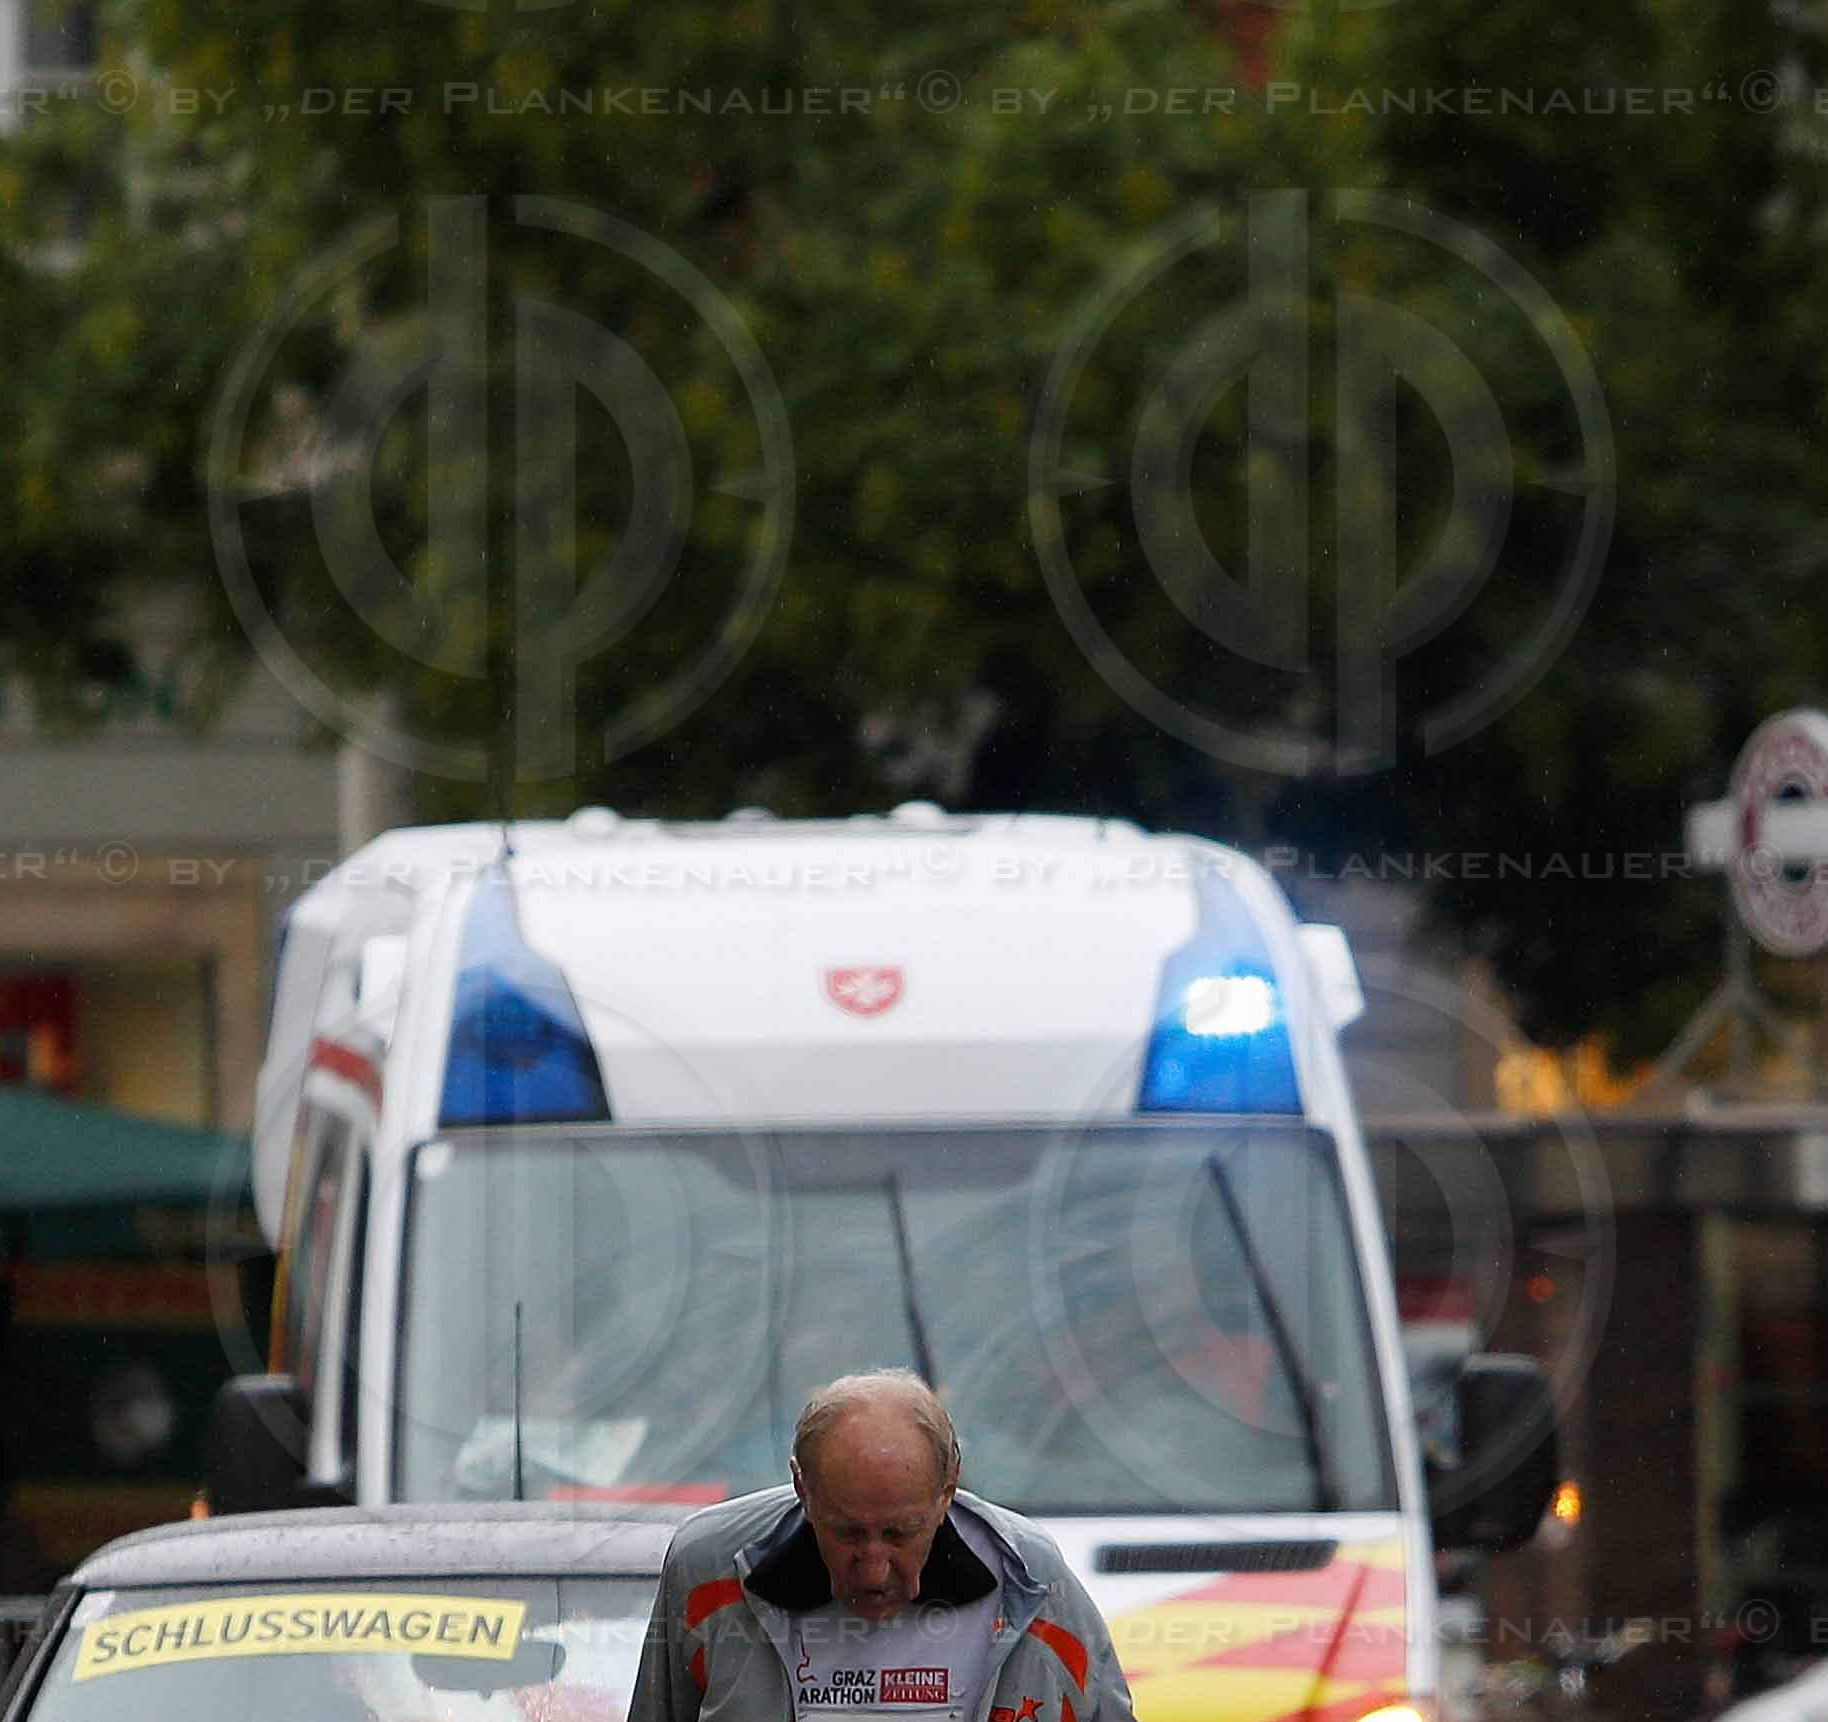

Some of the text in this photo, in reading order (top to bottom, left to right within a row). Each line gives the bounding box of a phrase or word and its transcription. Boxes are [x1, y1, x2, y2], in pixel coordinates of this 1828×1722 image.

[91, 1608, 507, 1664] SCHLUSSWAGEN
[832, 1669, 876, 1687] GRAZ
[884, 1671, 945, 1686] KLEINE
